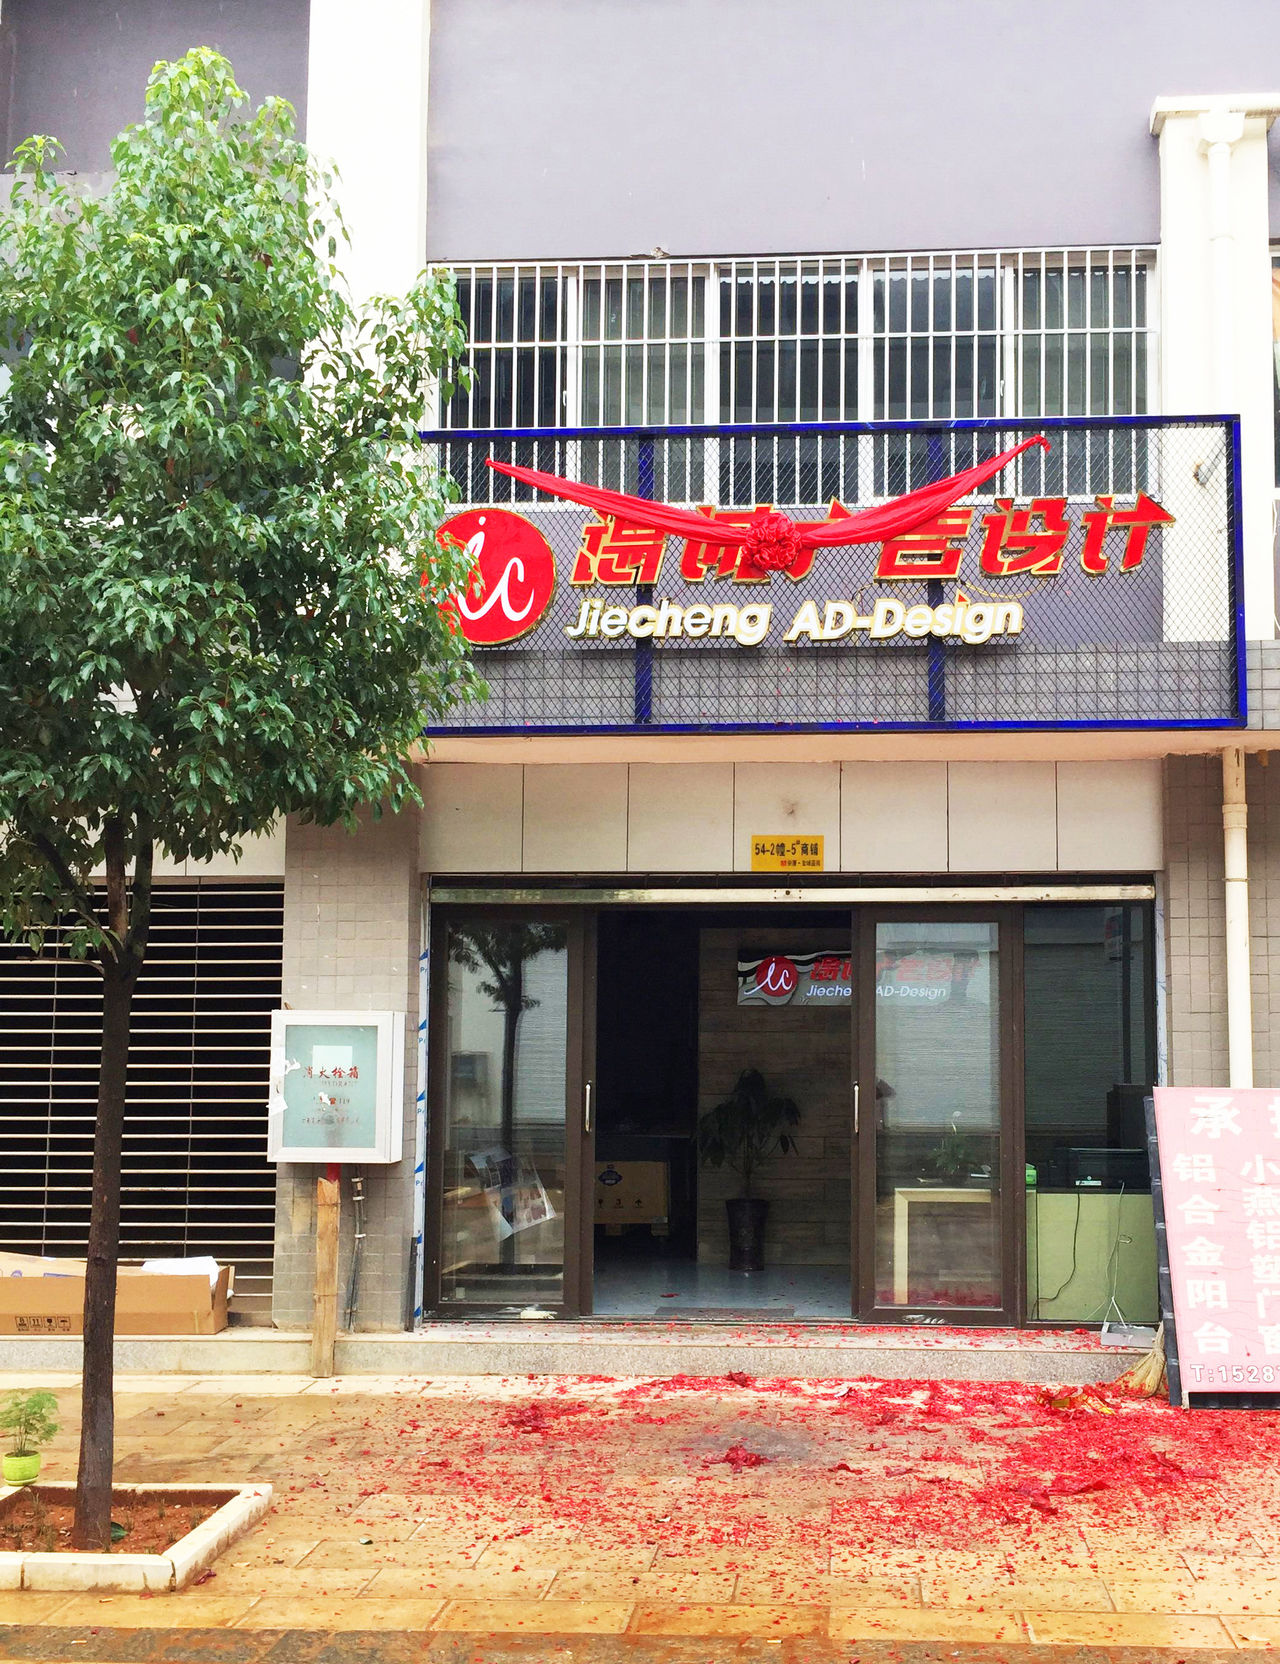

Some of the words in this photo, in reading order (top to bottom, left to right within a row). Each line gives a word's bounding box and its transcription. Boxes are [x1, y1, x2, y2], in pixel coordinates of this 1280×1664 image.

[566, 598, 773, 647] Jiecheng
[783, 597, 1024, 646] AD-Design
[303, 1066, 359, 1079] 消火栓箱
[1190, 1096, 1280, 1139] 承
[1172, 1153, 1234, 1355] 铝合金阳台
